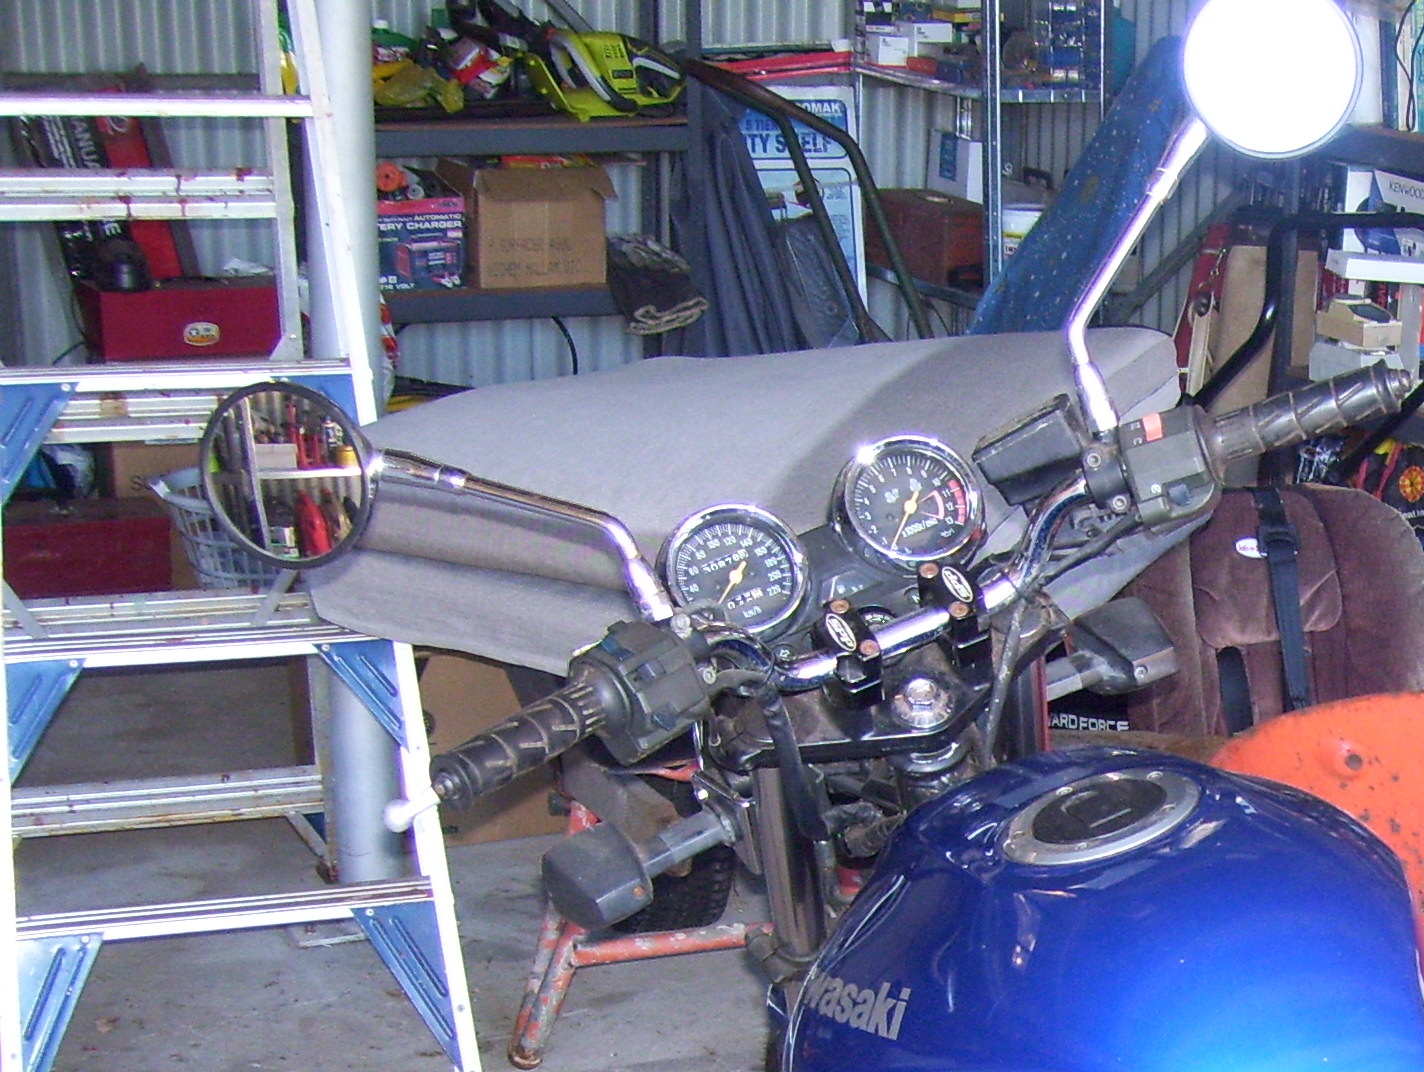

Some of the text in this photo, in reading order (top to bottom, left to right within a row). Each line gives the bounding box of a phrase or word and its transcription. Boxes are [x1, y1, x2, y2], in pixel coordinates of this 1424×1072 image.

[775, 134, 831, 153] SELF
[406, 221, 462, 230] CHARGER
[801, 972, 912, 1041] wasaki
